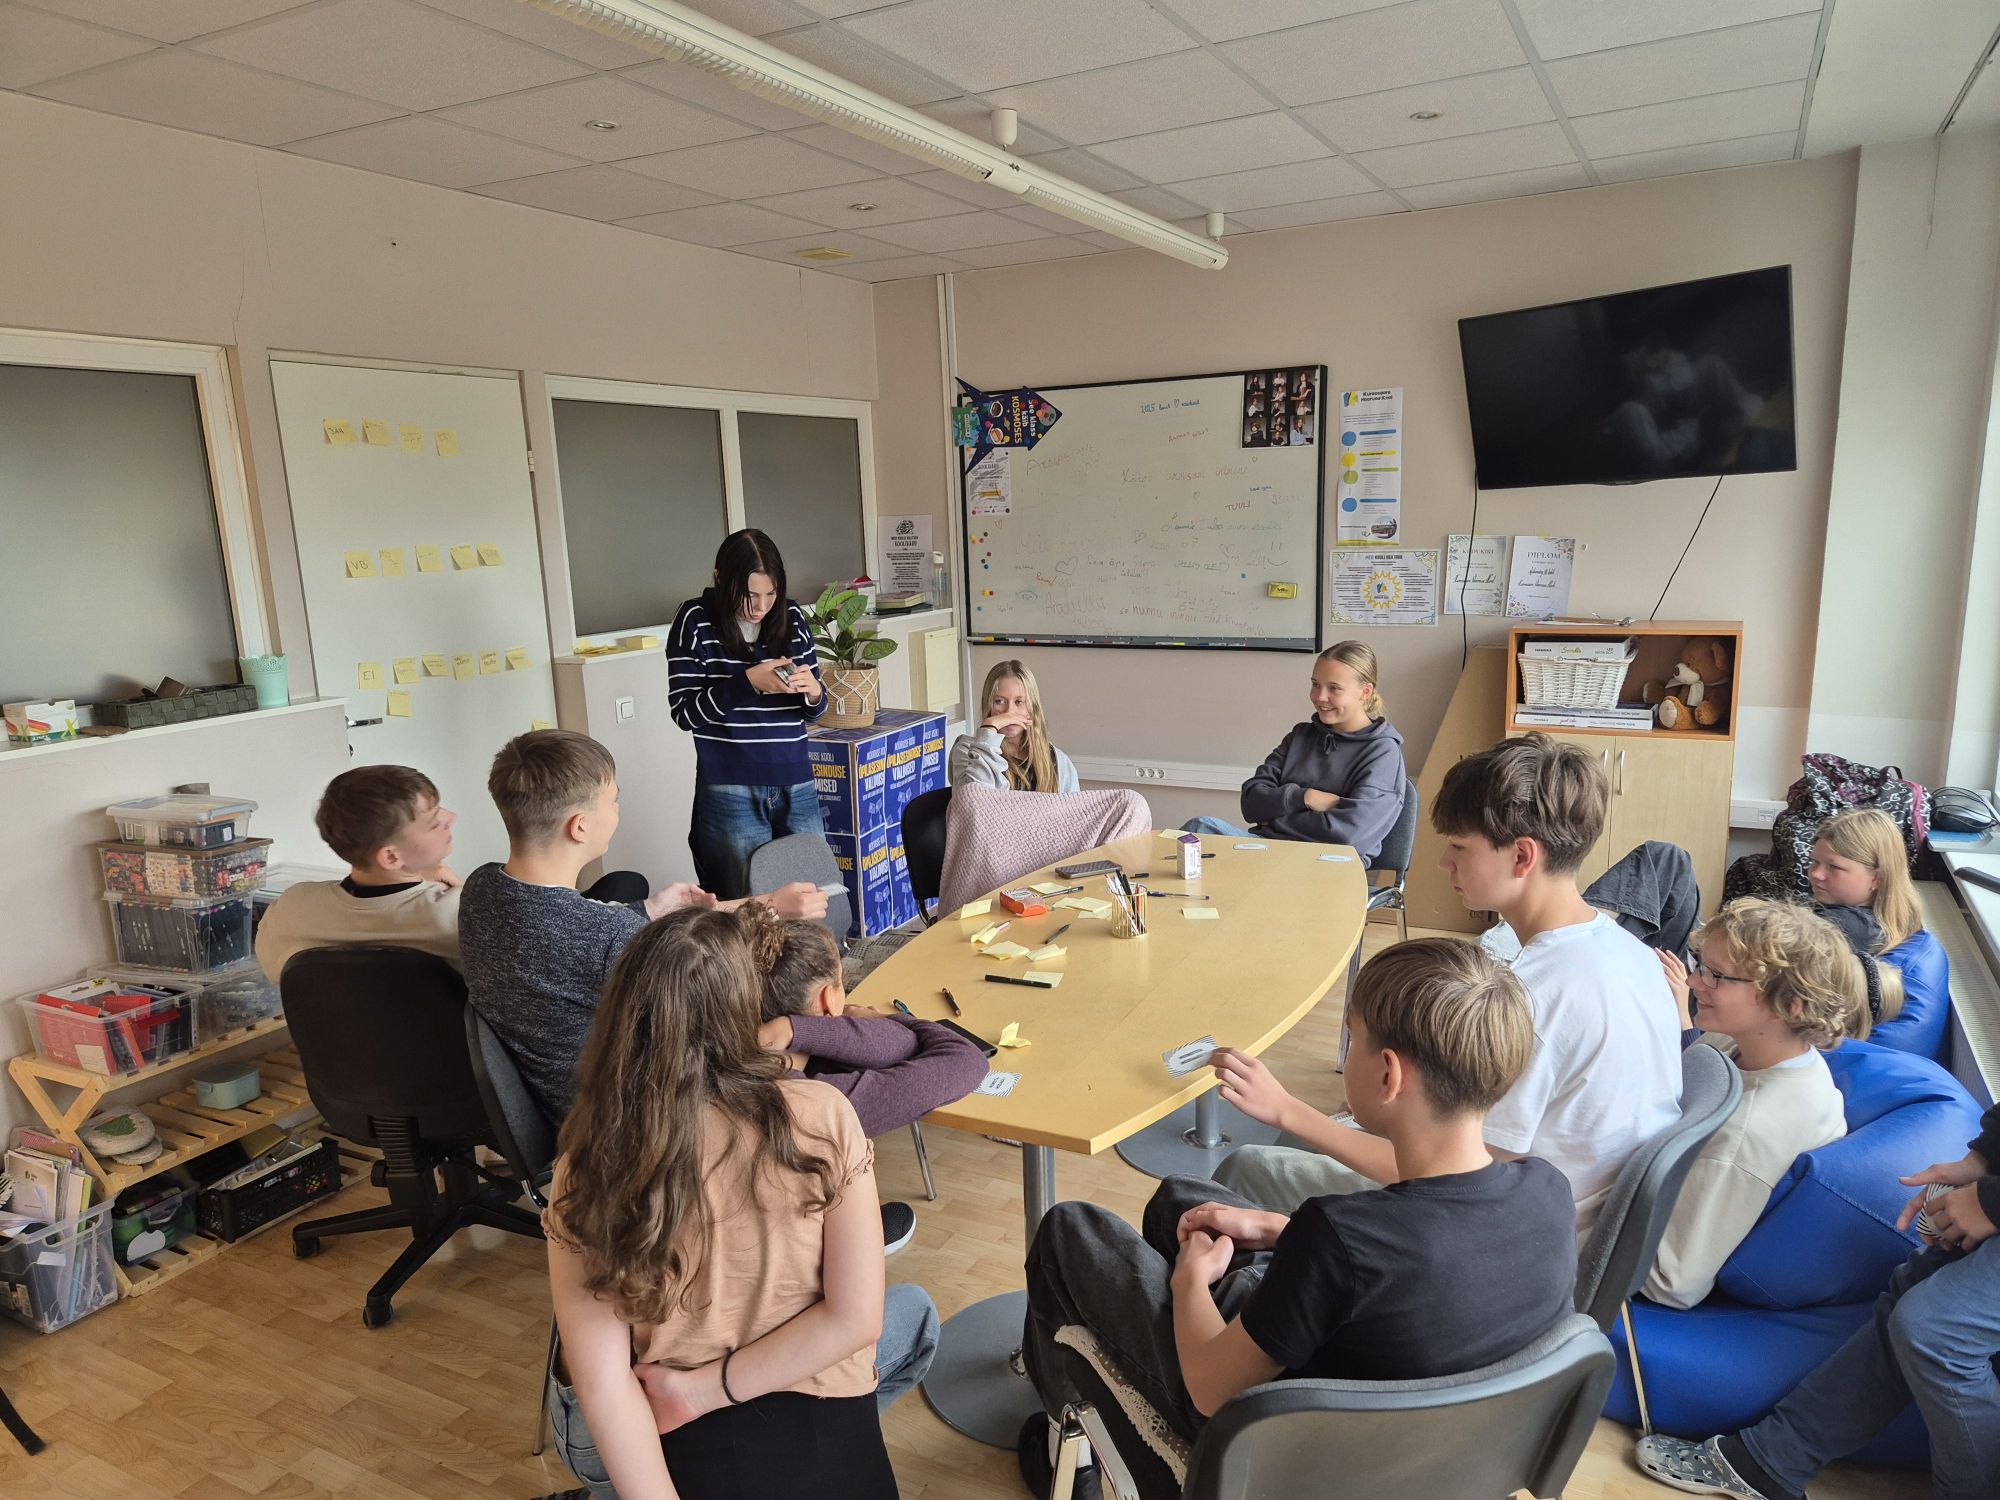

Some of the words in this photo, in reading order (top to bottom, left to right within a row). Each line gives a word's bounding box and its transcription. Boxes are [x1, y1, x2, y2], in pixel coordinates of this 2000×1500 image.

[1011, 396, 1023, 444] KOSMOSES
[1029, 415, 1038, 437] klass
[1527, 551, 1561, 560] DIPLOM
[350, 559, 369, 571] VB
[808, 752, 822, 760] RUSE
[812, 764, 846, 779] ESINDUSE
[814, 778, 838, 793] MISED
[864, 770, 886, 793] VALIMIS
[869, 859, 889, 882] VALIMIS
